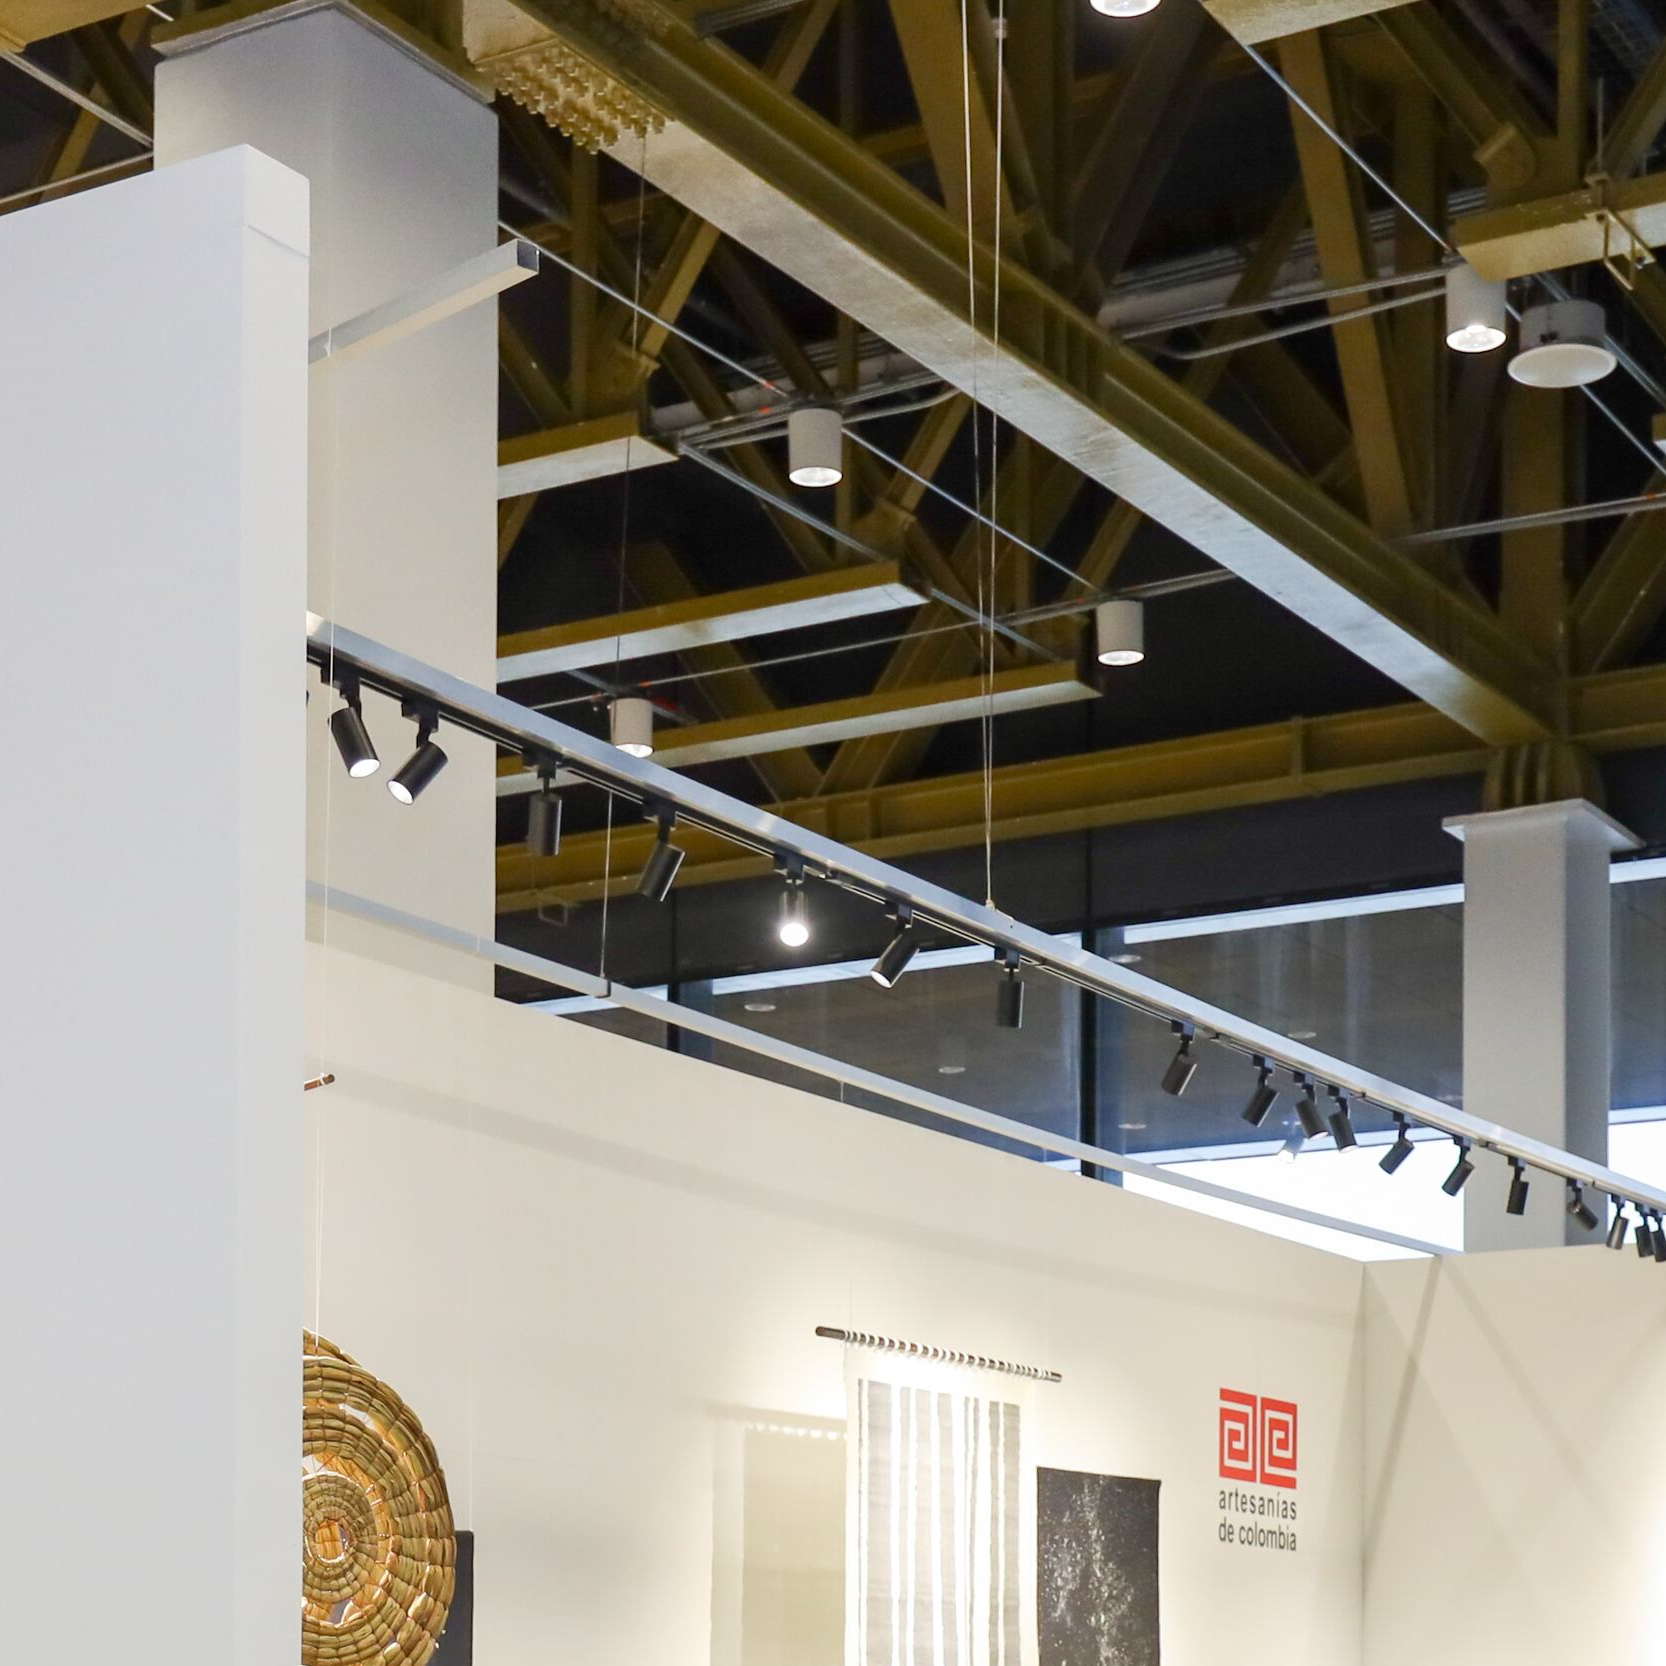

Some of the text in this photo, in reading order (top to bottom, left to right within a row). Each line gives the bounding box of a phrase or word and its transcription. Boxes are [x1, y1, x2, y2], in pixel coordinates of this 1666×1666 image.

[1219, 1488, 1297, 1520] artesanías
[1219, 1517, 1297, 1551] de colombia
